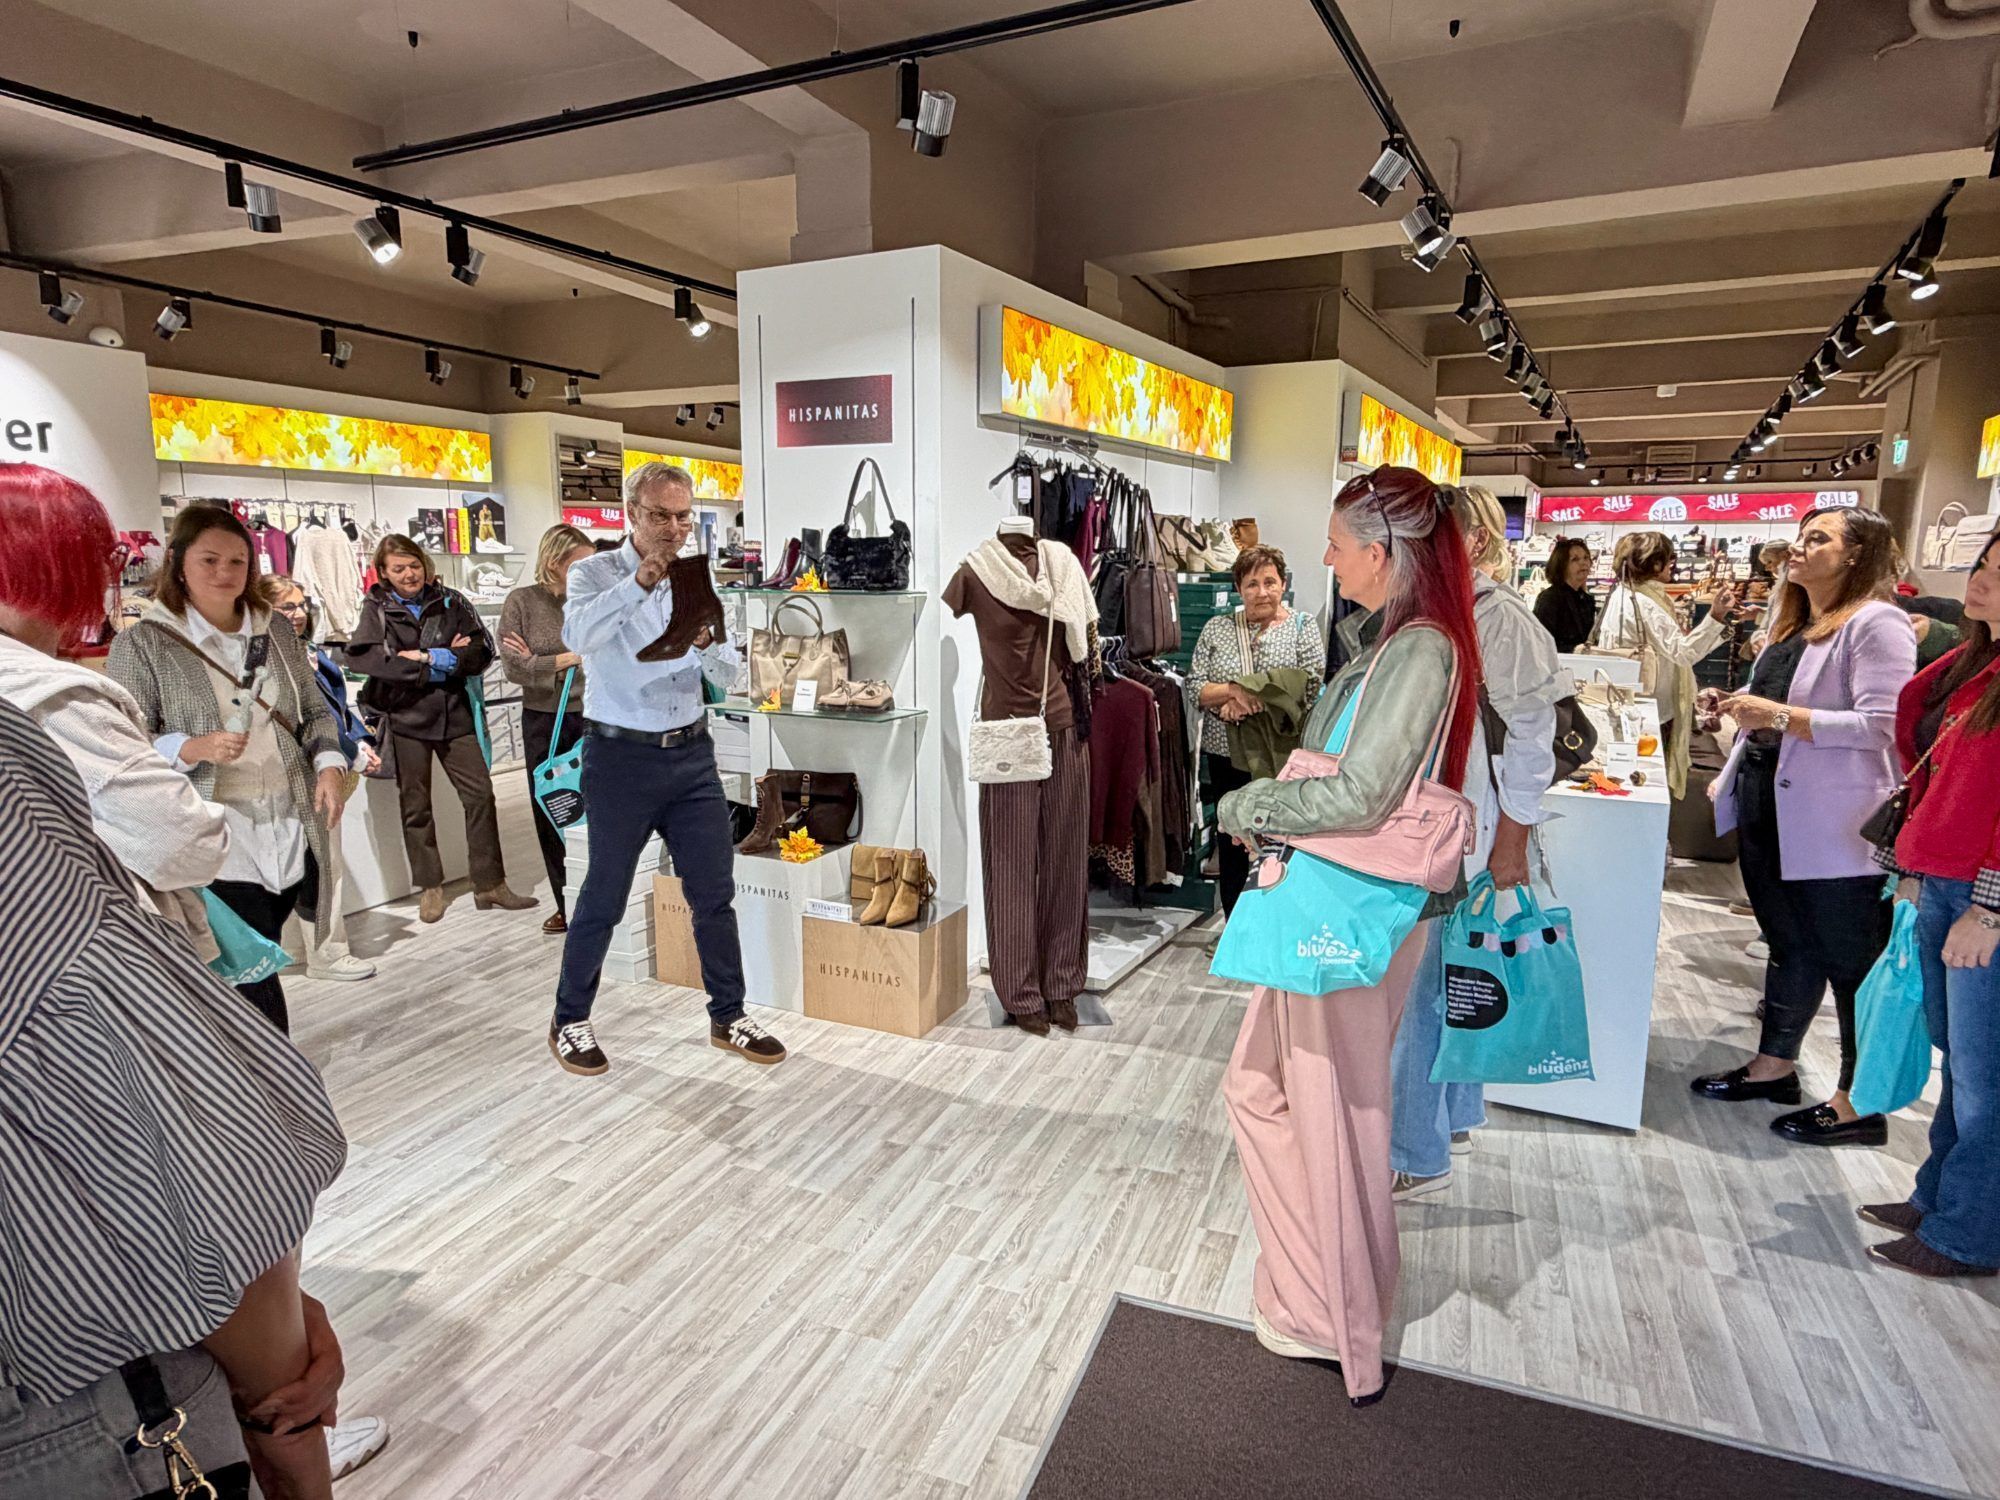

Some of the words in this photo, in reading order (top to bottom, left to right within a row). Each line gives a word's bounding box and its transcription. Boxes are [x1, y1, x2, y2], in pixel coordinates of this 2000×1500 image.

[788, 403, 879, 422] HISPANITAS
[0, 418, 53, 453] er
[1603, 495, 1633, 510] SALE
[1708, 493, 1740, 510] SALE
[1819, 492, 1854, 507] SALE
[1551, 507, 1582, 521] SALE
[1652, 505, 1682, 521] SALE
[1759, 504, 1793, 520] SALE
[736, 884, 789, 900] ISPANITAS
[820, 963, 902, 988] HISPANITAS
[1527, 1060, 1590, 1076] bludenz
